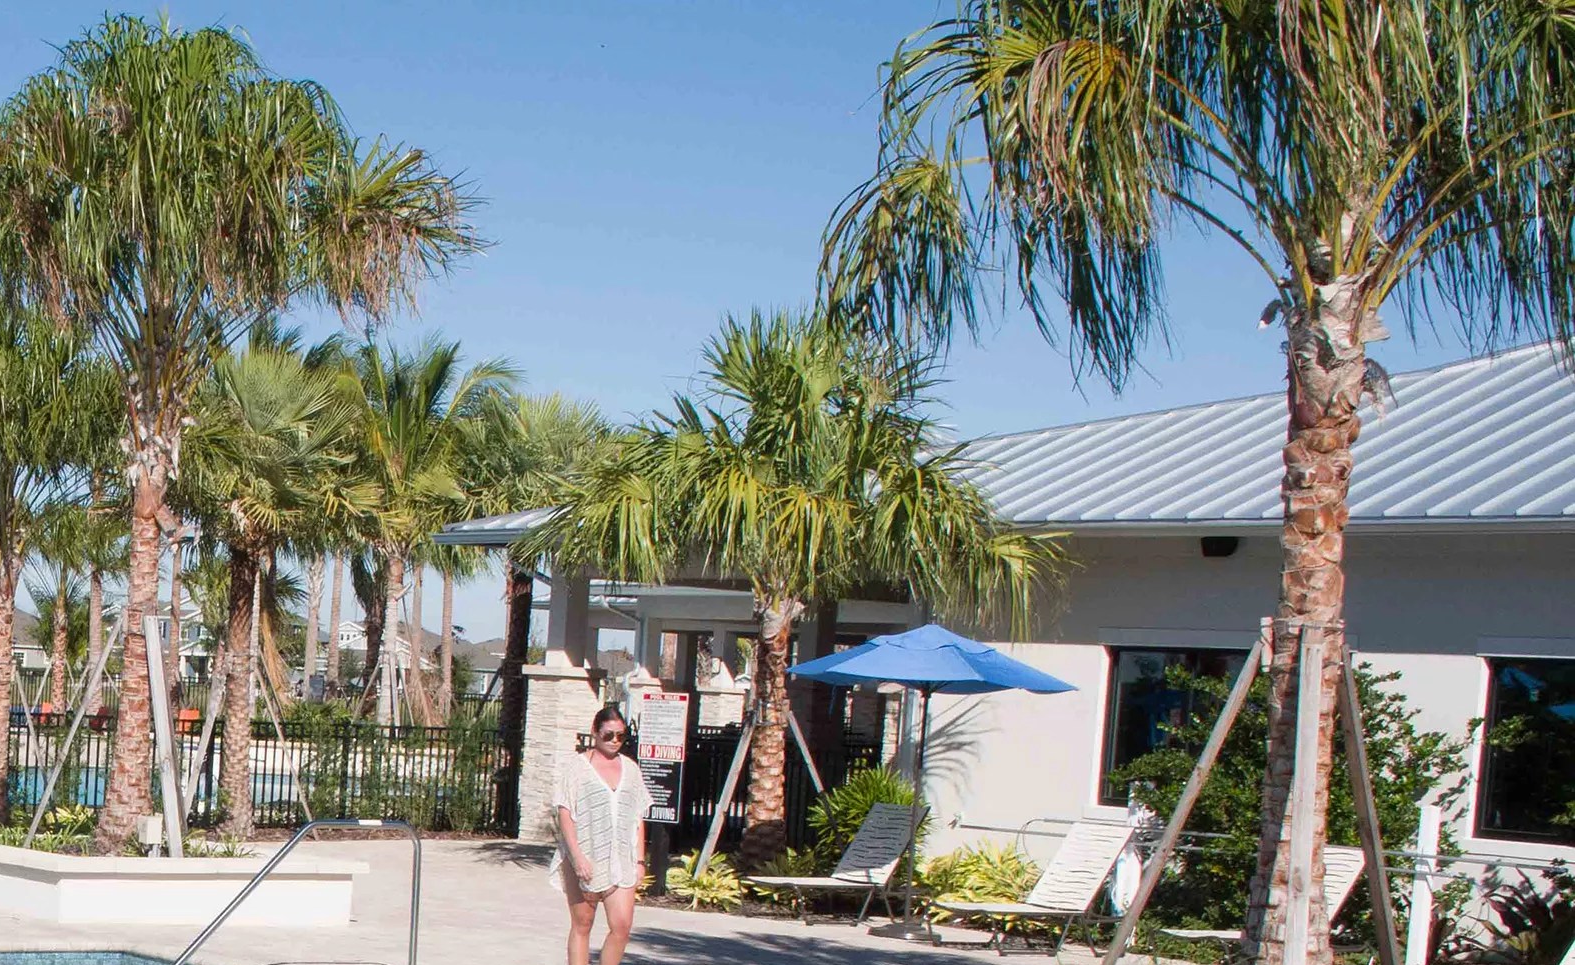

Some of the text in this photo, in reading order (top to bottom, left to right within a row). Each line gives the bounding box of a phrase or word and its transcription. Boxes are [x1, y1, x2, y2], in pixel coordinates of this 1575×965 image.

[640, 745, 682, 760] NO DIVING
[652, 807, 675, 820] DIVING
